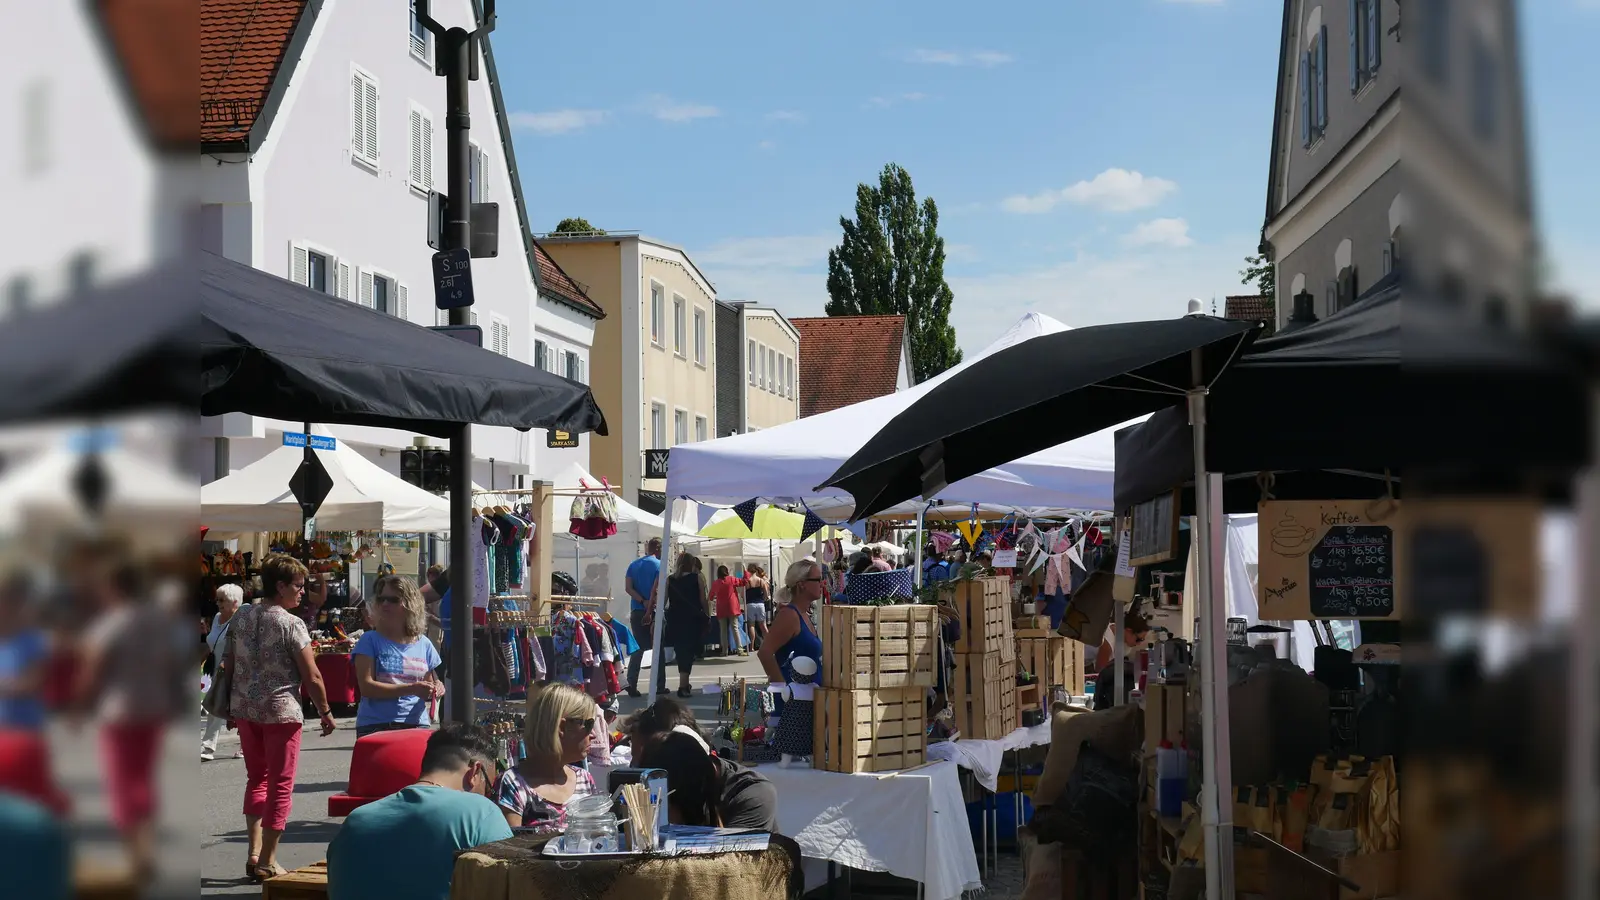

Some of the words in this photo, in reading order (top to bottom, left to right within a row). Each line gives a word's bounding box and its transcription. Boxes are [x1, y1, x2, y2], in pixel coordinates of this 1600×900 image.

[442, 258, 451, 272] S
[455, 260, 469, 270] 100
[1320, 511, 1360, 526] Kaffee
